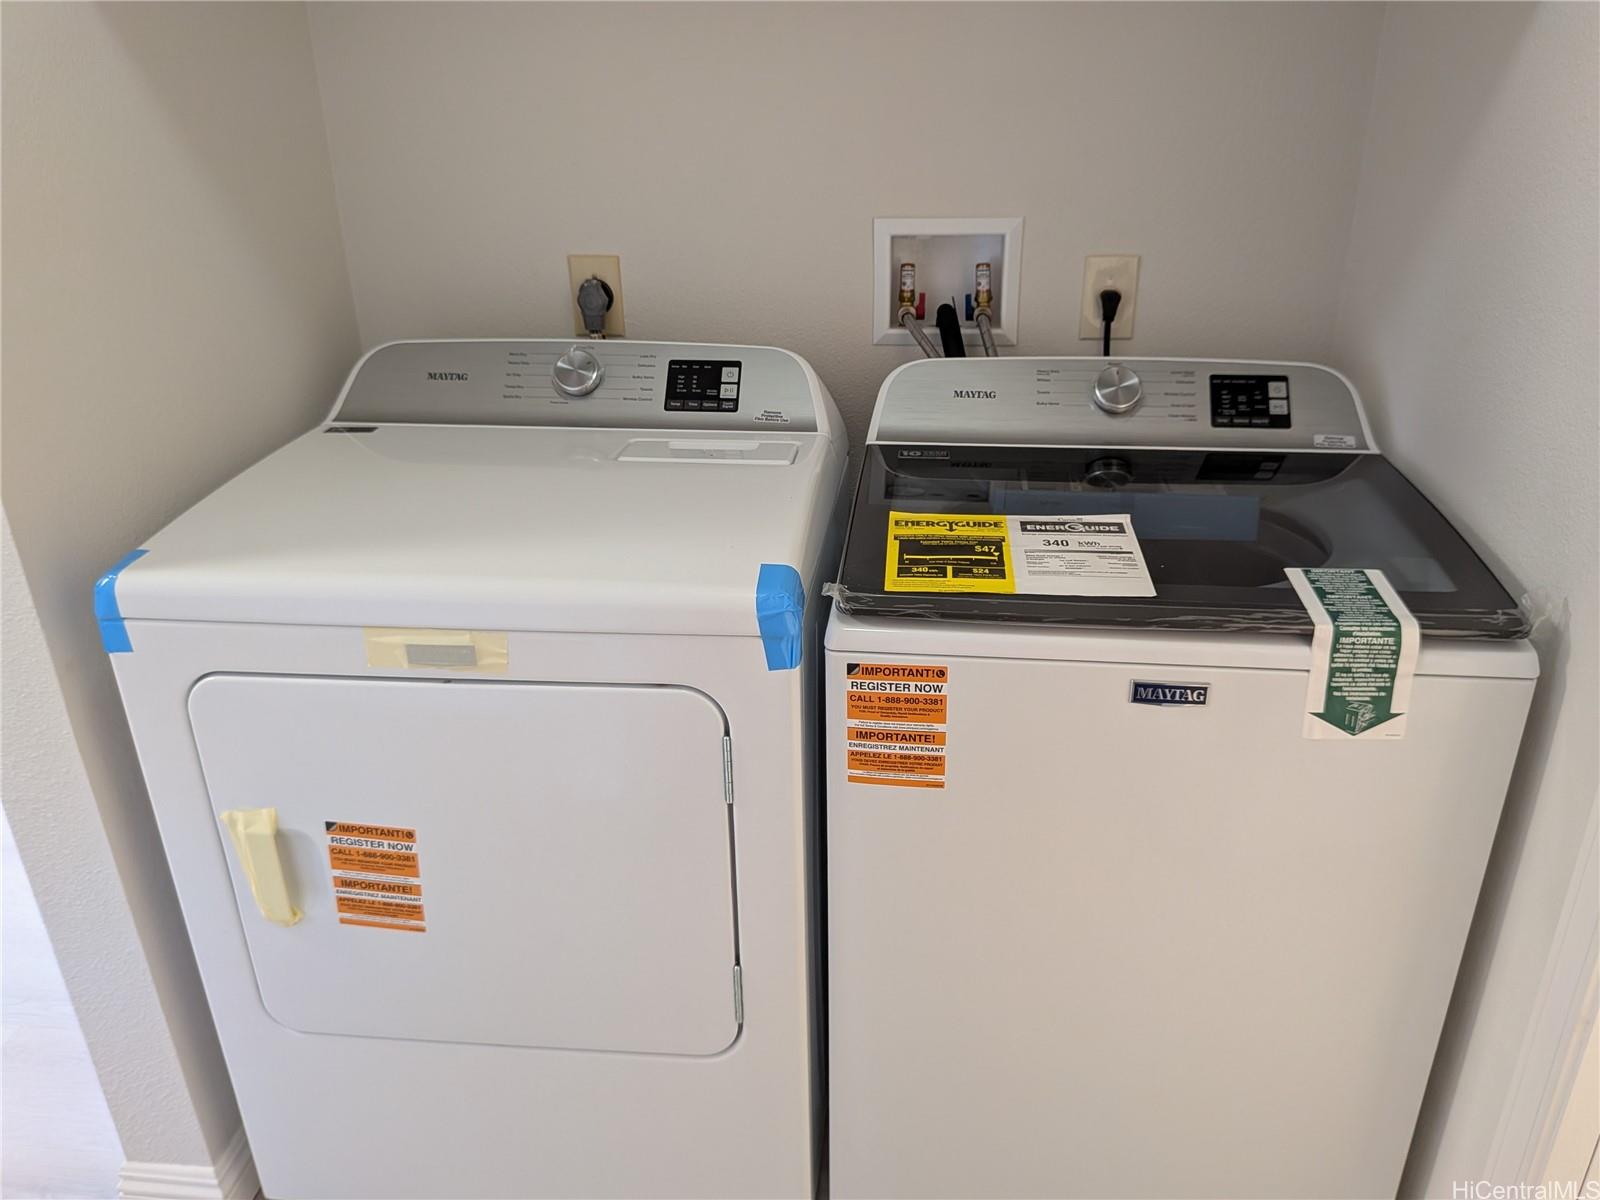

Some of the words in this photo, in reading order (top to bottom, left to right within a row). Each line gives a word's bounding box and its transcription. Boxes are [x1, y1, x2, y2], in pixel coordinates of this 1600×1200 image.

[427, 372, 469, 381] MAYTAG
[953, 390, 997, 399] MAYTAG
[894, 520, 1005, 529] ENERGYGUIDE
[1042, 539, 1070, 547] 340
[974, 545, 996, 553] $47
[1339, 637, 1396, 645] IMPORTANTE
[861, 666, 936, 678] IMPORTANT!
[850, 681, 911, 692] REGISTER
[915, 683, 944, 693] NOW
[1135, 686, 1205, 702] MAYTAG
[850, 694, 875, 703] CALL
[877, 696, 943, 706] 1-888-900-3381
[855, 730, 936, 743] IMPORTANTE!
[849, 742, 897, 751] ENREGISTREZ
[898, 745, 945, 753] MAINTENANT
[894, 754, 943, 762] 1-888-900-3381
[340, 825, 405, 838] IMPORTANT!
[330, 836, 385, 848] REGISTER
[388, 842, 414, 851] NOW
[331, 848, 354, 856] CALL
[341, 880, 413, 893] IMPORTANTE!
